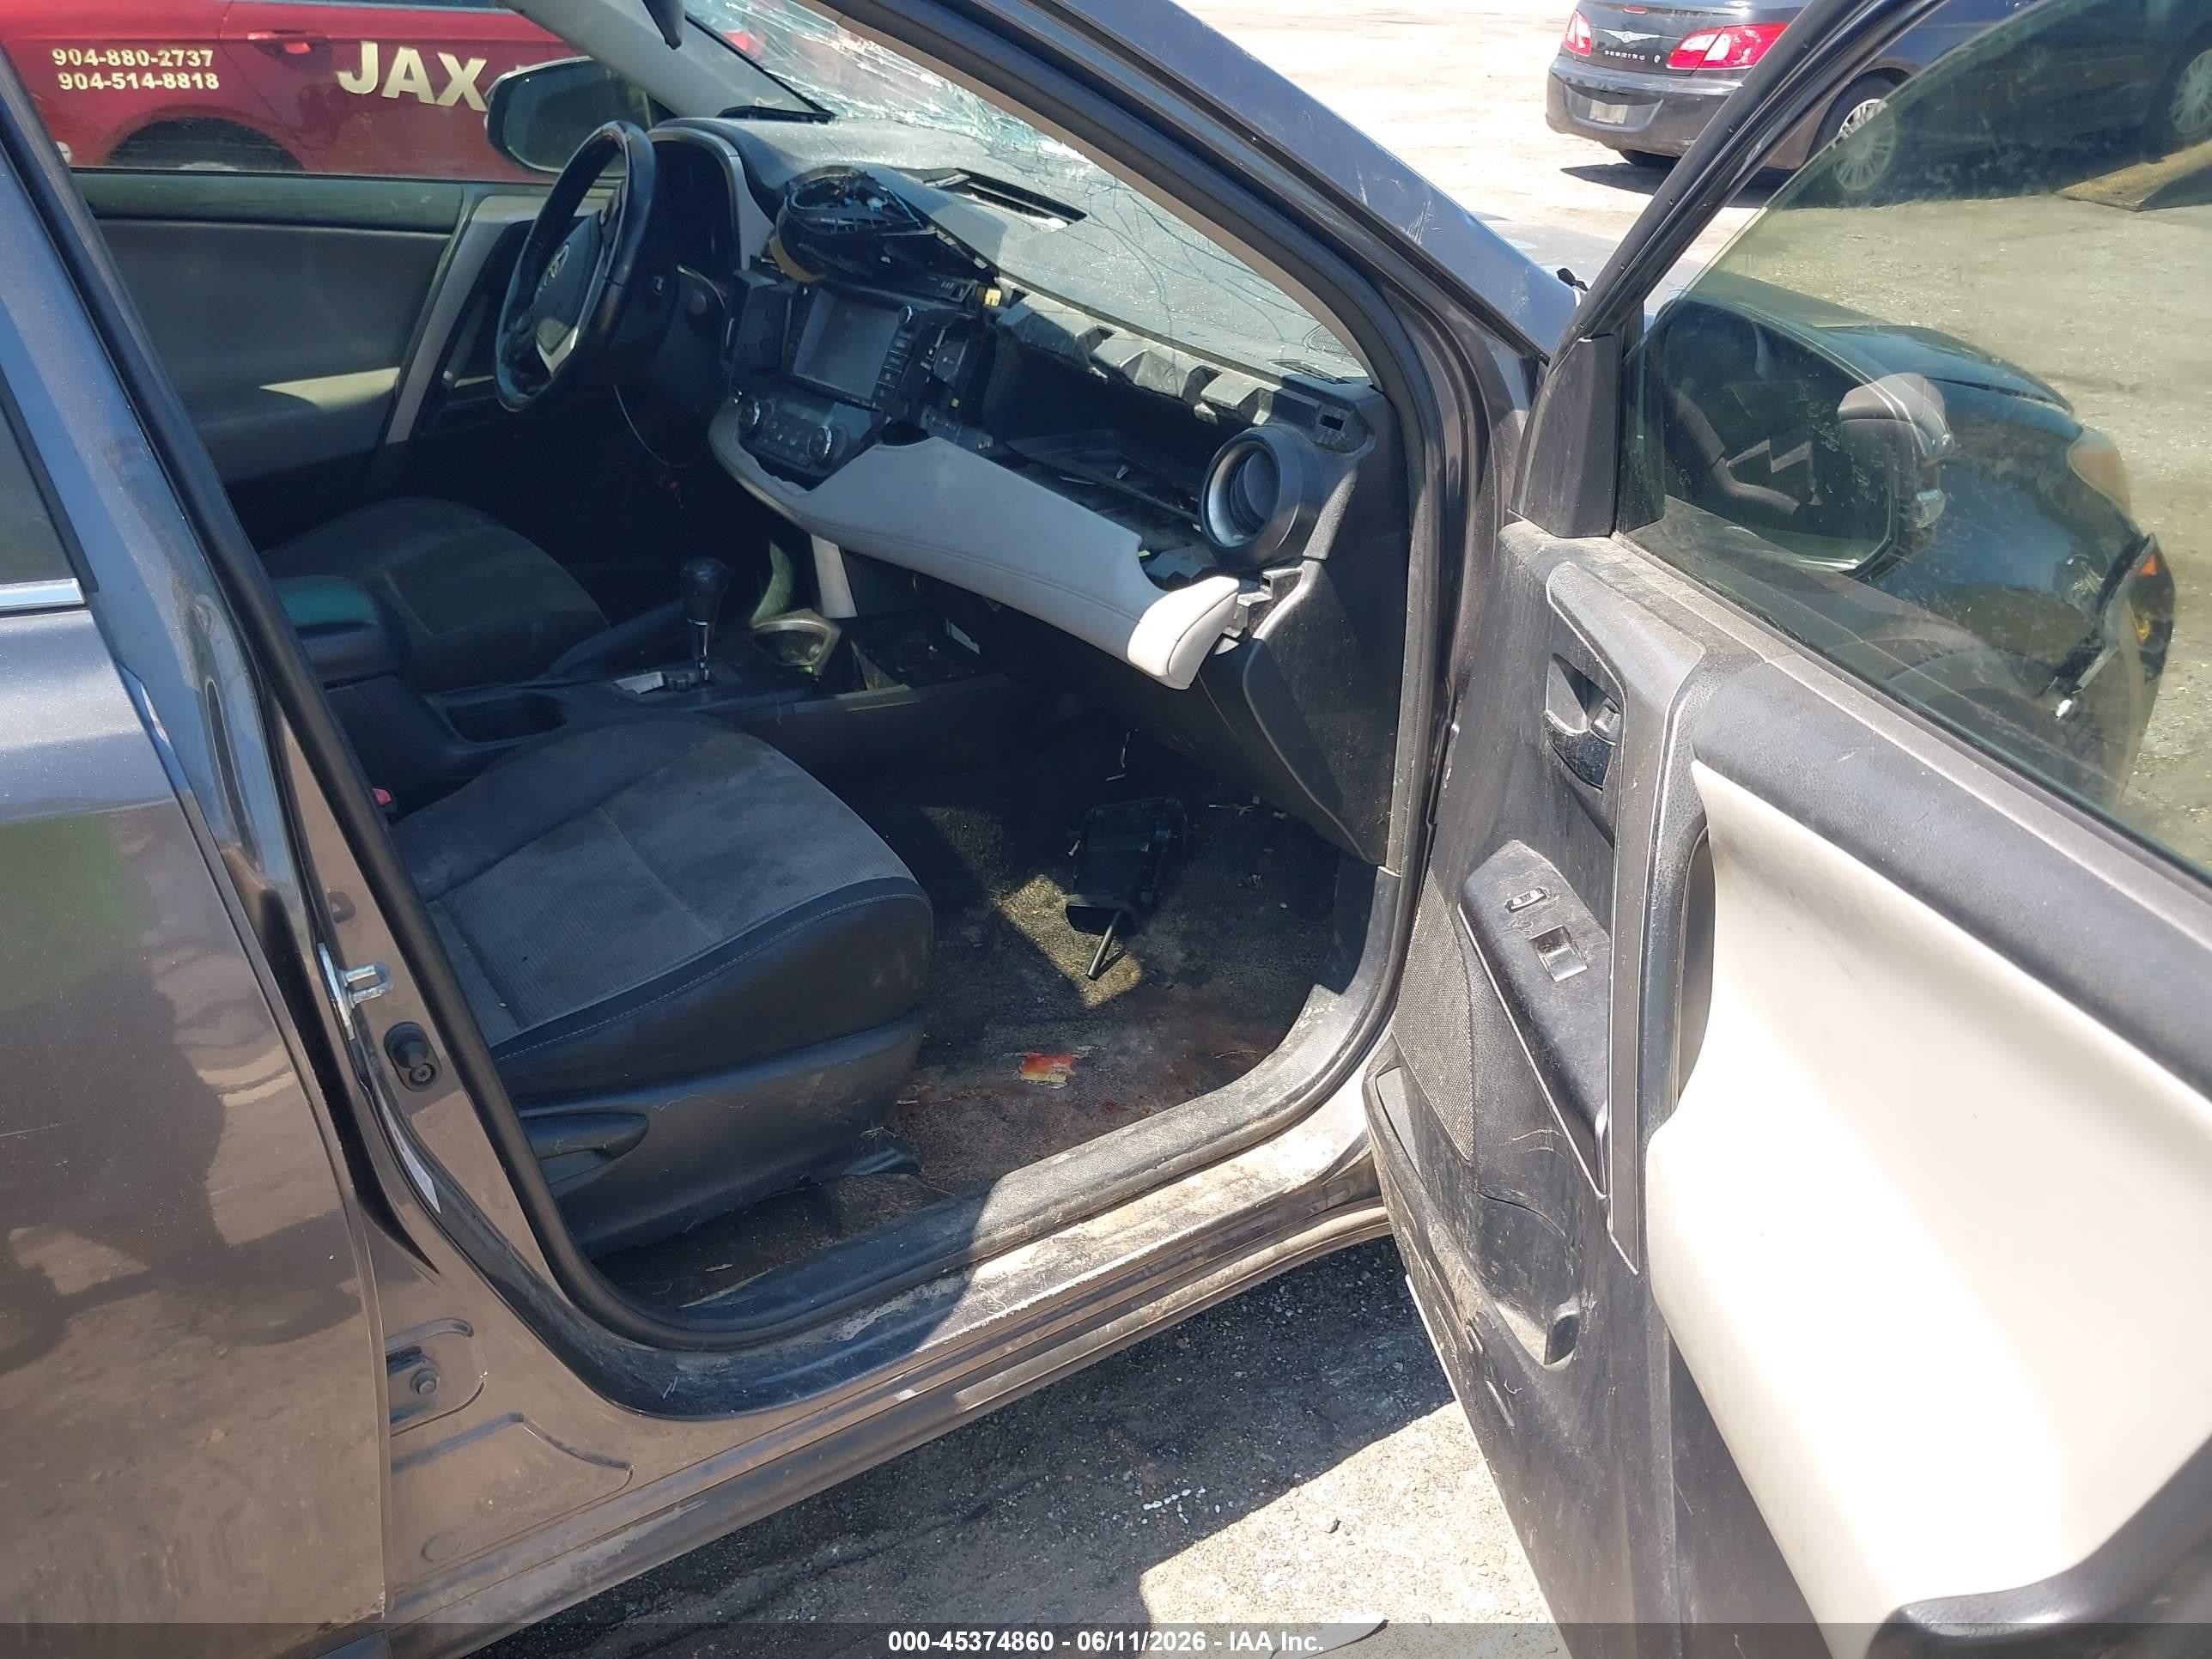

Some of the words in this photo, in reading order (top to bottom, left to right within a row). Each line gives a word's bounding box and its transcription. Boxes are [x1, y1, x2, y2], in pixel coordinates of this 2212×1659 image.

[52, 48, 214, 67] 904-880-2737
[58, 72, 220, 90] 904-514-8818
[336, 40, 488, 112] JAX
